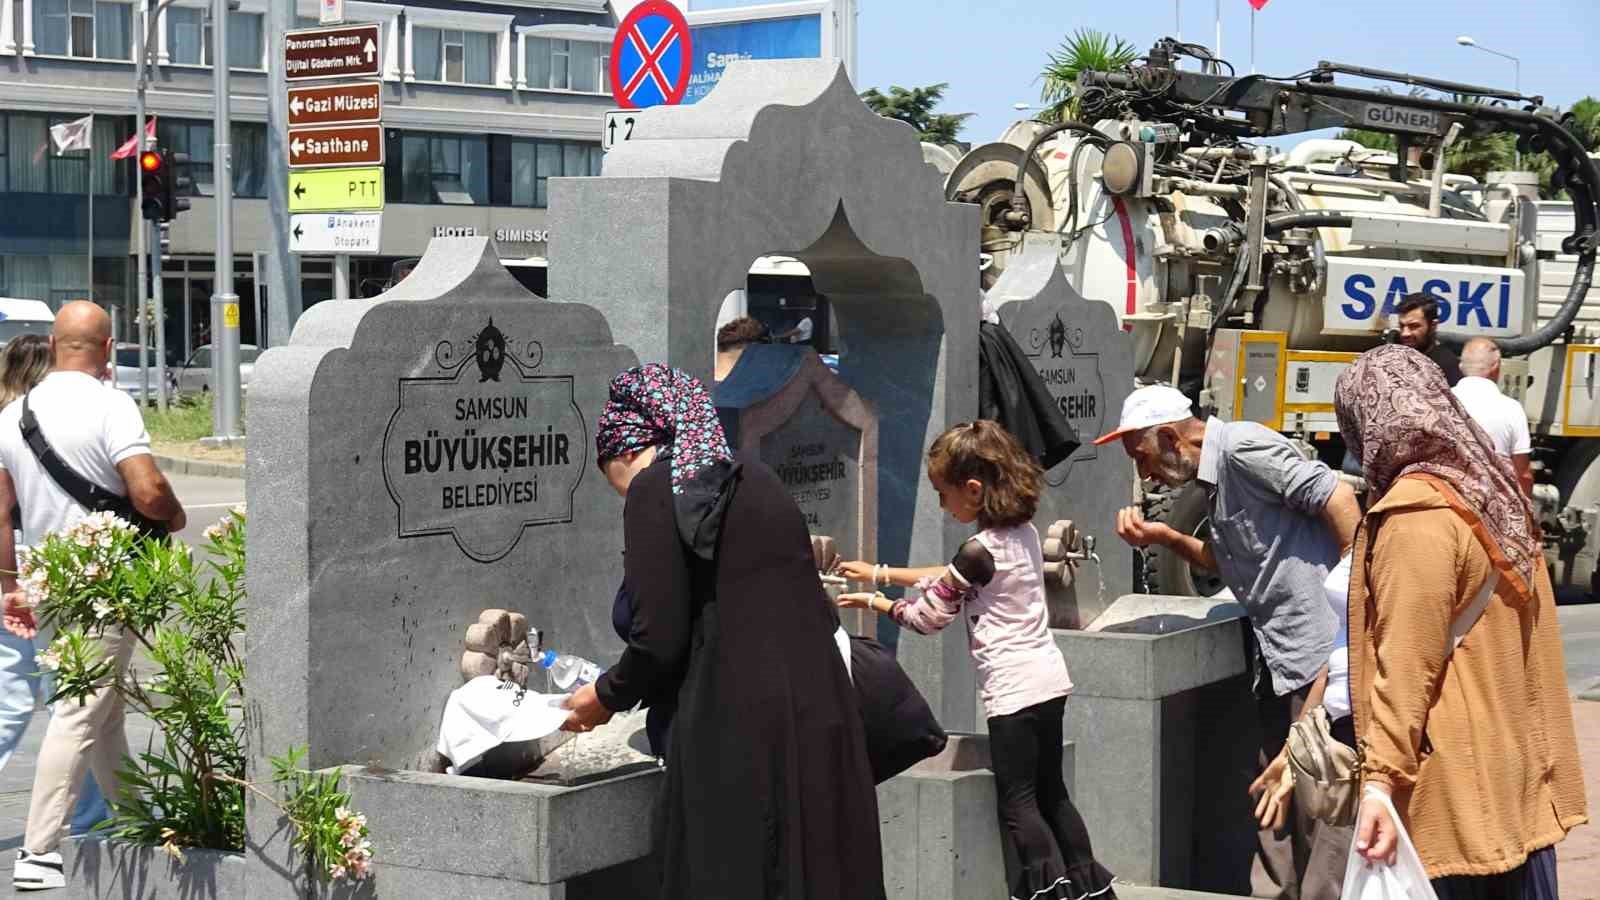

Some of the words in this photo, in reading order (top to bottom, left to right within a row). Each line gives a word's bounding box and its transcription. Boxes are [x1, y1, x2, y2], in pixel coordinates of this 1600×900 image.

[286, 38, 327, 50] Panorama
[328, 35, 361, 47] Samsun
[305, 96, 332, 112] Gazi
[334, 93, 378, 111] Müzesi
[306, 137, 369, 154] Saathane
[348, 180, 377, 197] PTT
[433, 226, 478, 238] HOTEL
[1341, 273, 1511, 329] SASKİ
[455, 397, 528, 421] SAMSUN
[404, 425, 571, 475] BÜYÜKŞEHİR
[442, 474, 538, 510] BELEDİYESİ
